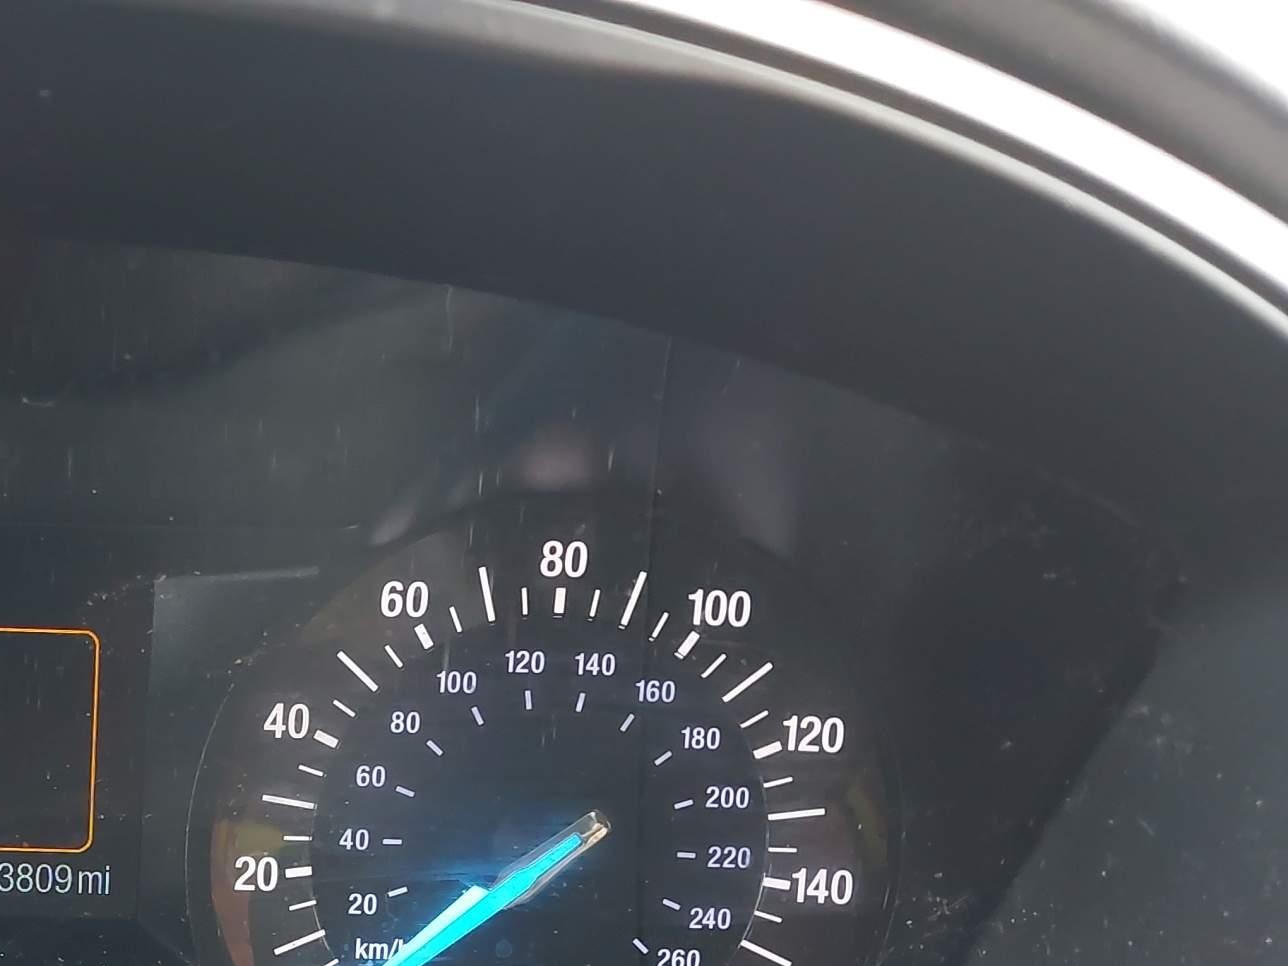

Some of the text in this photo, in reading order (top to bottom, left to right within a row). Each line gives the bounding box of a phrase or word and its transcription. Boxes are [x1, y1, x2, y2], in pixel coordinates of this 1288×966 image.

[541, 541, 587, 577] 80
[381, 581, 428, 617] 60
[688, 588, 752, 628] 100
[506, 651, 544, 673] 120
[576, 653, 615, 675] 140
[437, 671, 476, 693] 100
[636, 680, 675, 702] 160
[264, 703, 309, 738] 40
[391, 712, 420, 733] 80
[682, 727, 720, 749] 180
[783, 715, 846, 753] 120
[357, 766, 385, 787] 60
[706, 787, 749, 808] 200
[340, 829, 368, 850] 40
[708, 847, 750, 868] 220
[234, 855, 278, 892] 20
[791, 868, 854, 904] 140
[349, 894, 377, 914] 20
[690, 908, 730, 929] 240
